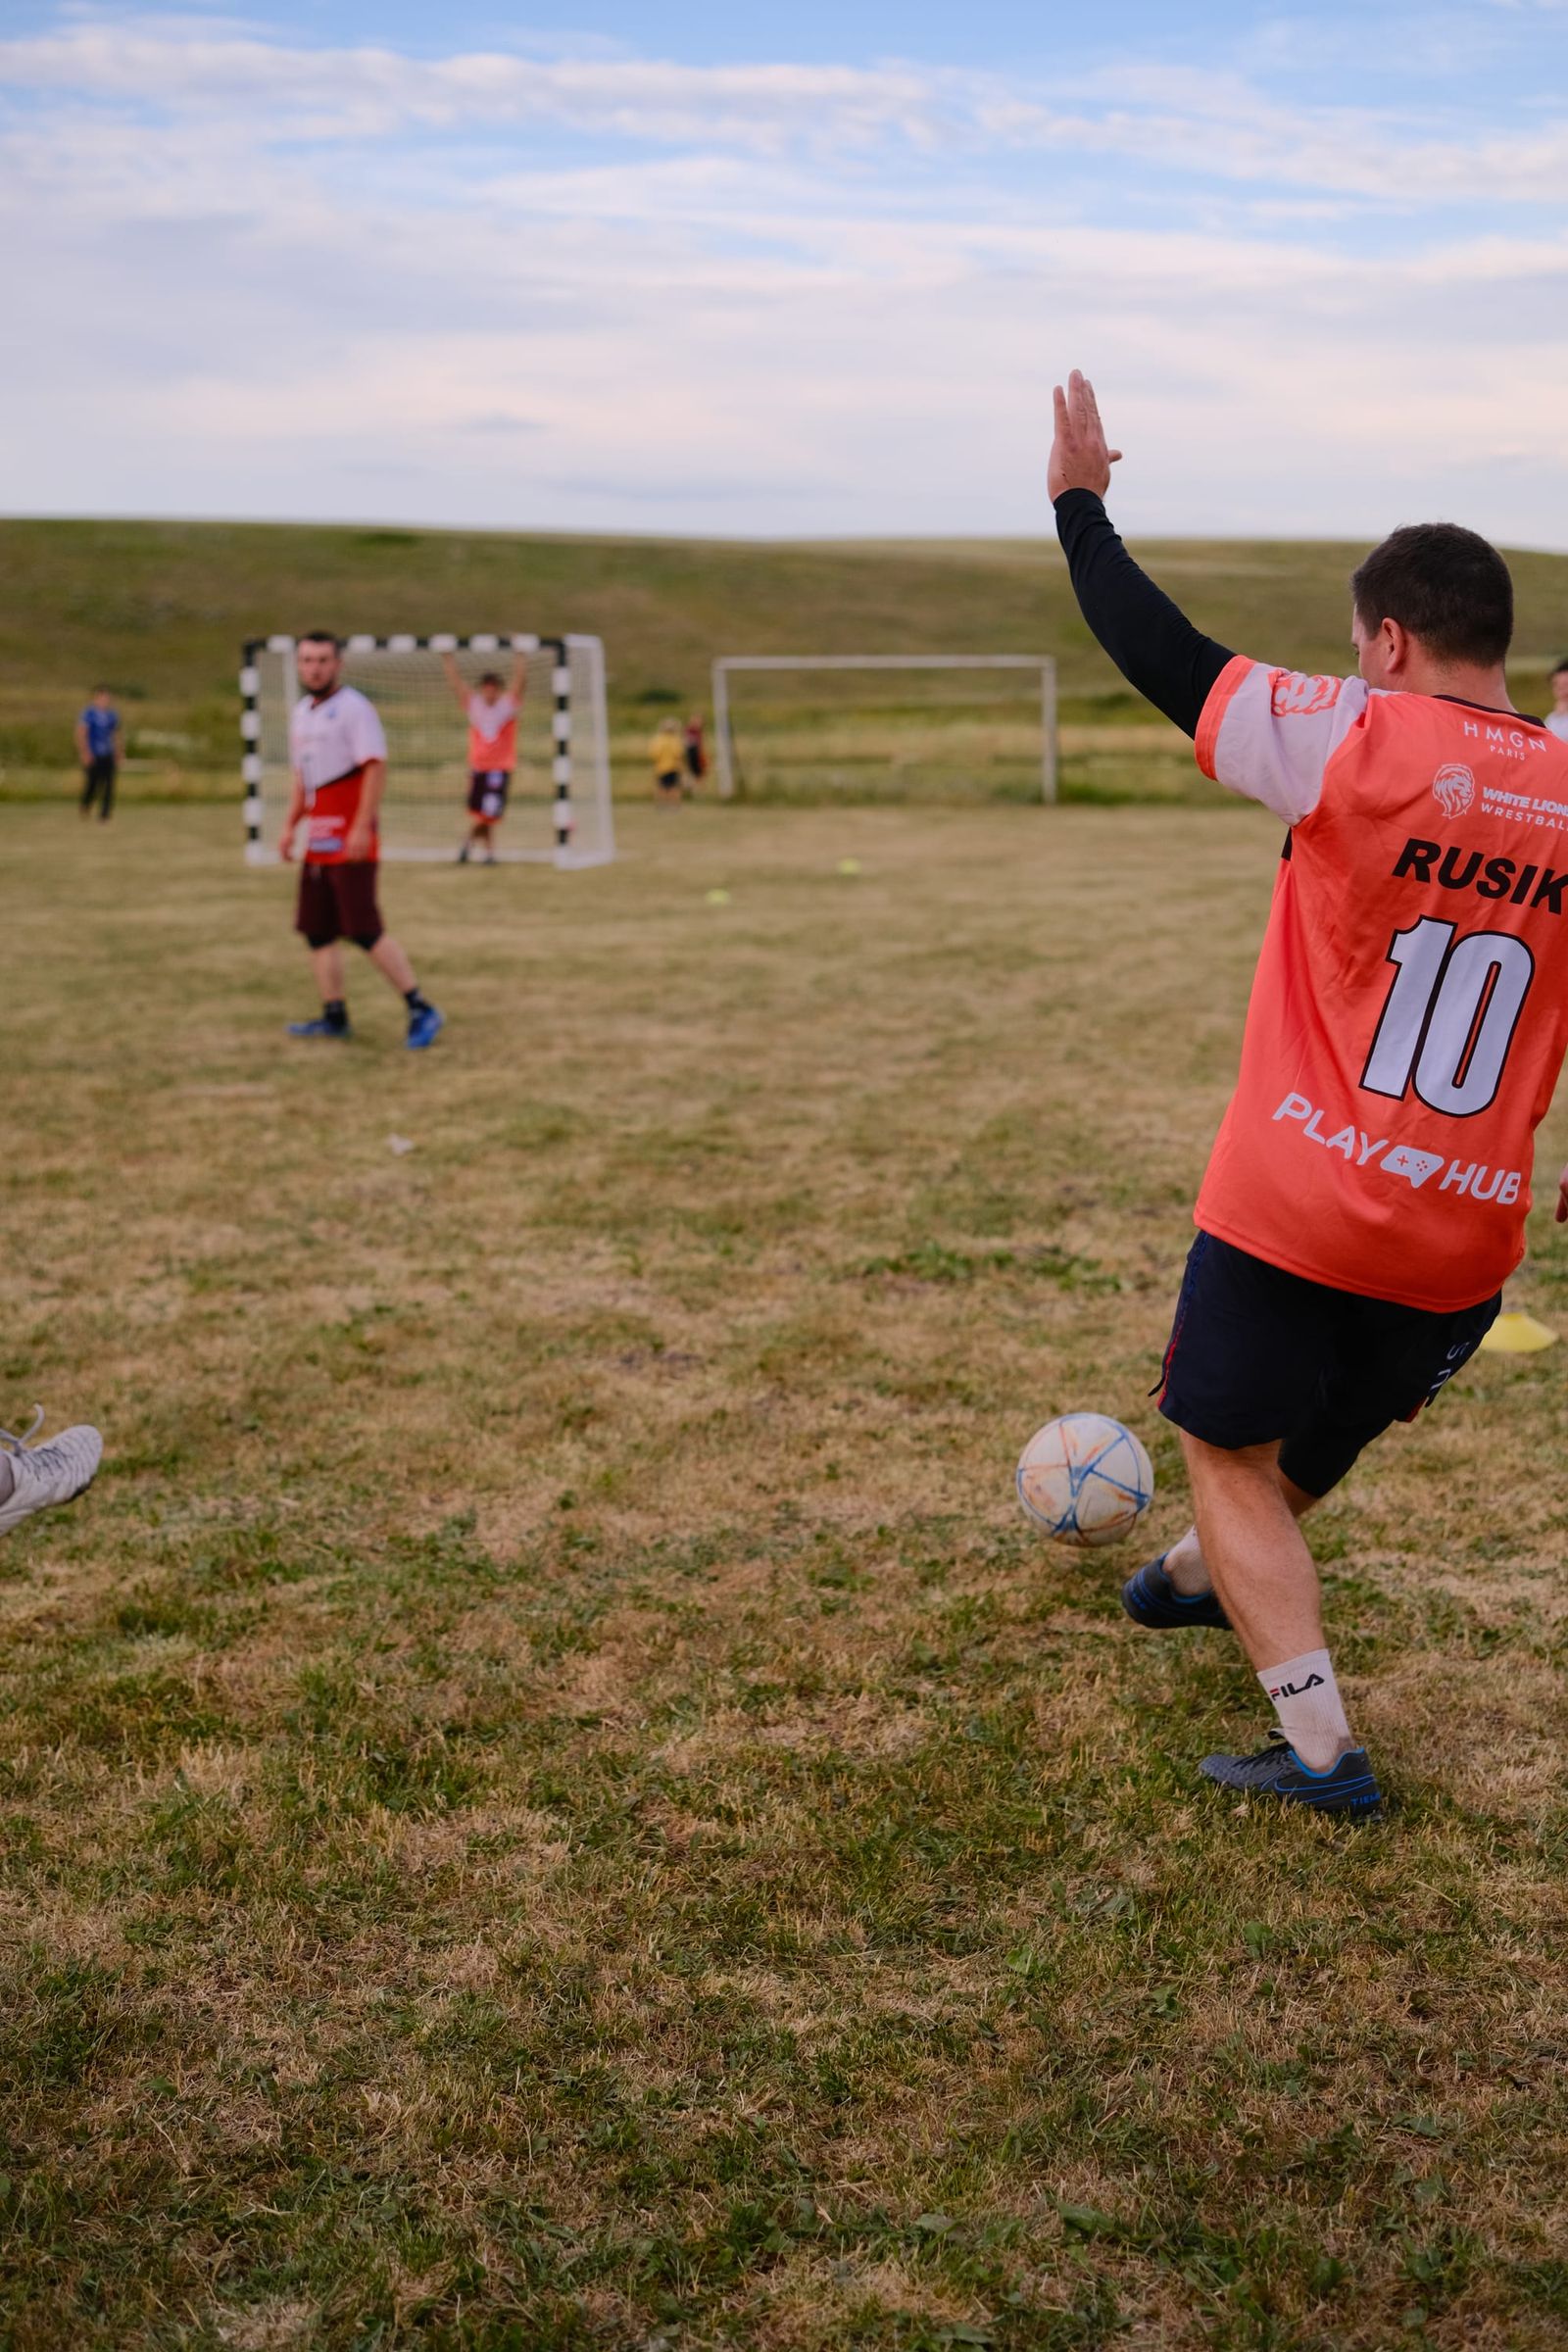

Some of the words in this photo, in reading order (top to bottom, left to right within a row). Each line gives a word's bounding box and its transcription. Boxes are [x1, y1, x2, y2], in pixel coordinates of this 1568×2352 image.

[1464, 721, 1546, 753] HMGN
[1490, 745, 1526, 760] PARIS
[1481, 803, 1568, 832] WRESTBAL
[1483, 787, 1531, 808] WHITE
[1532, 799, 1568, 817] LION
[1392, 838, 1568, 915] RUSIK
[1358, 914, 1535, 1118] 10
[1272, 1092, 1389, 1165] PLAY
[1439, 1159, 1521, 1205] HUB
[1269, 1673, 1325, 1701] FILA
